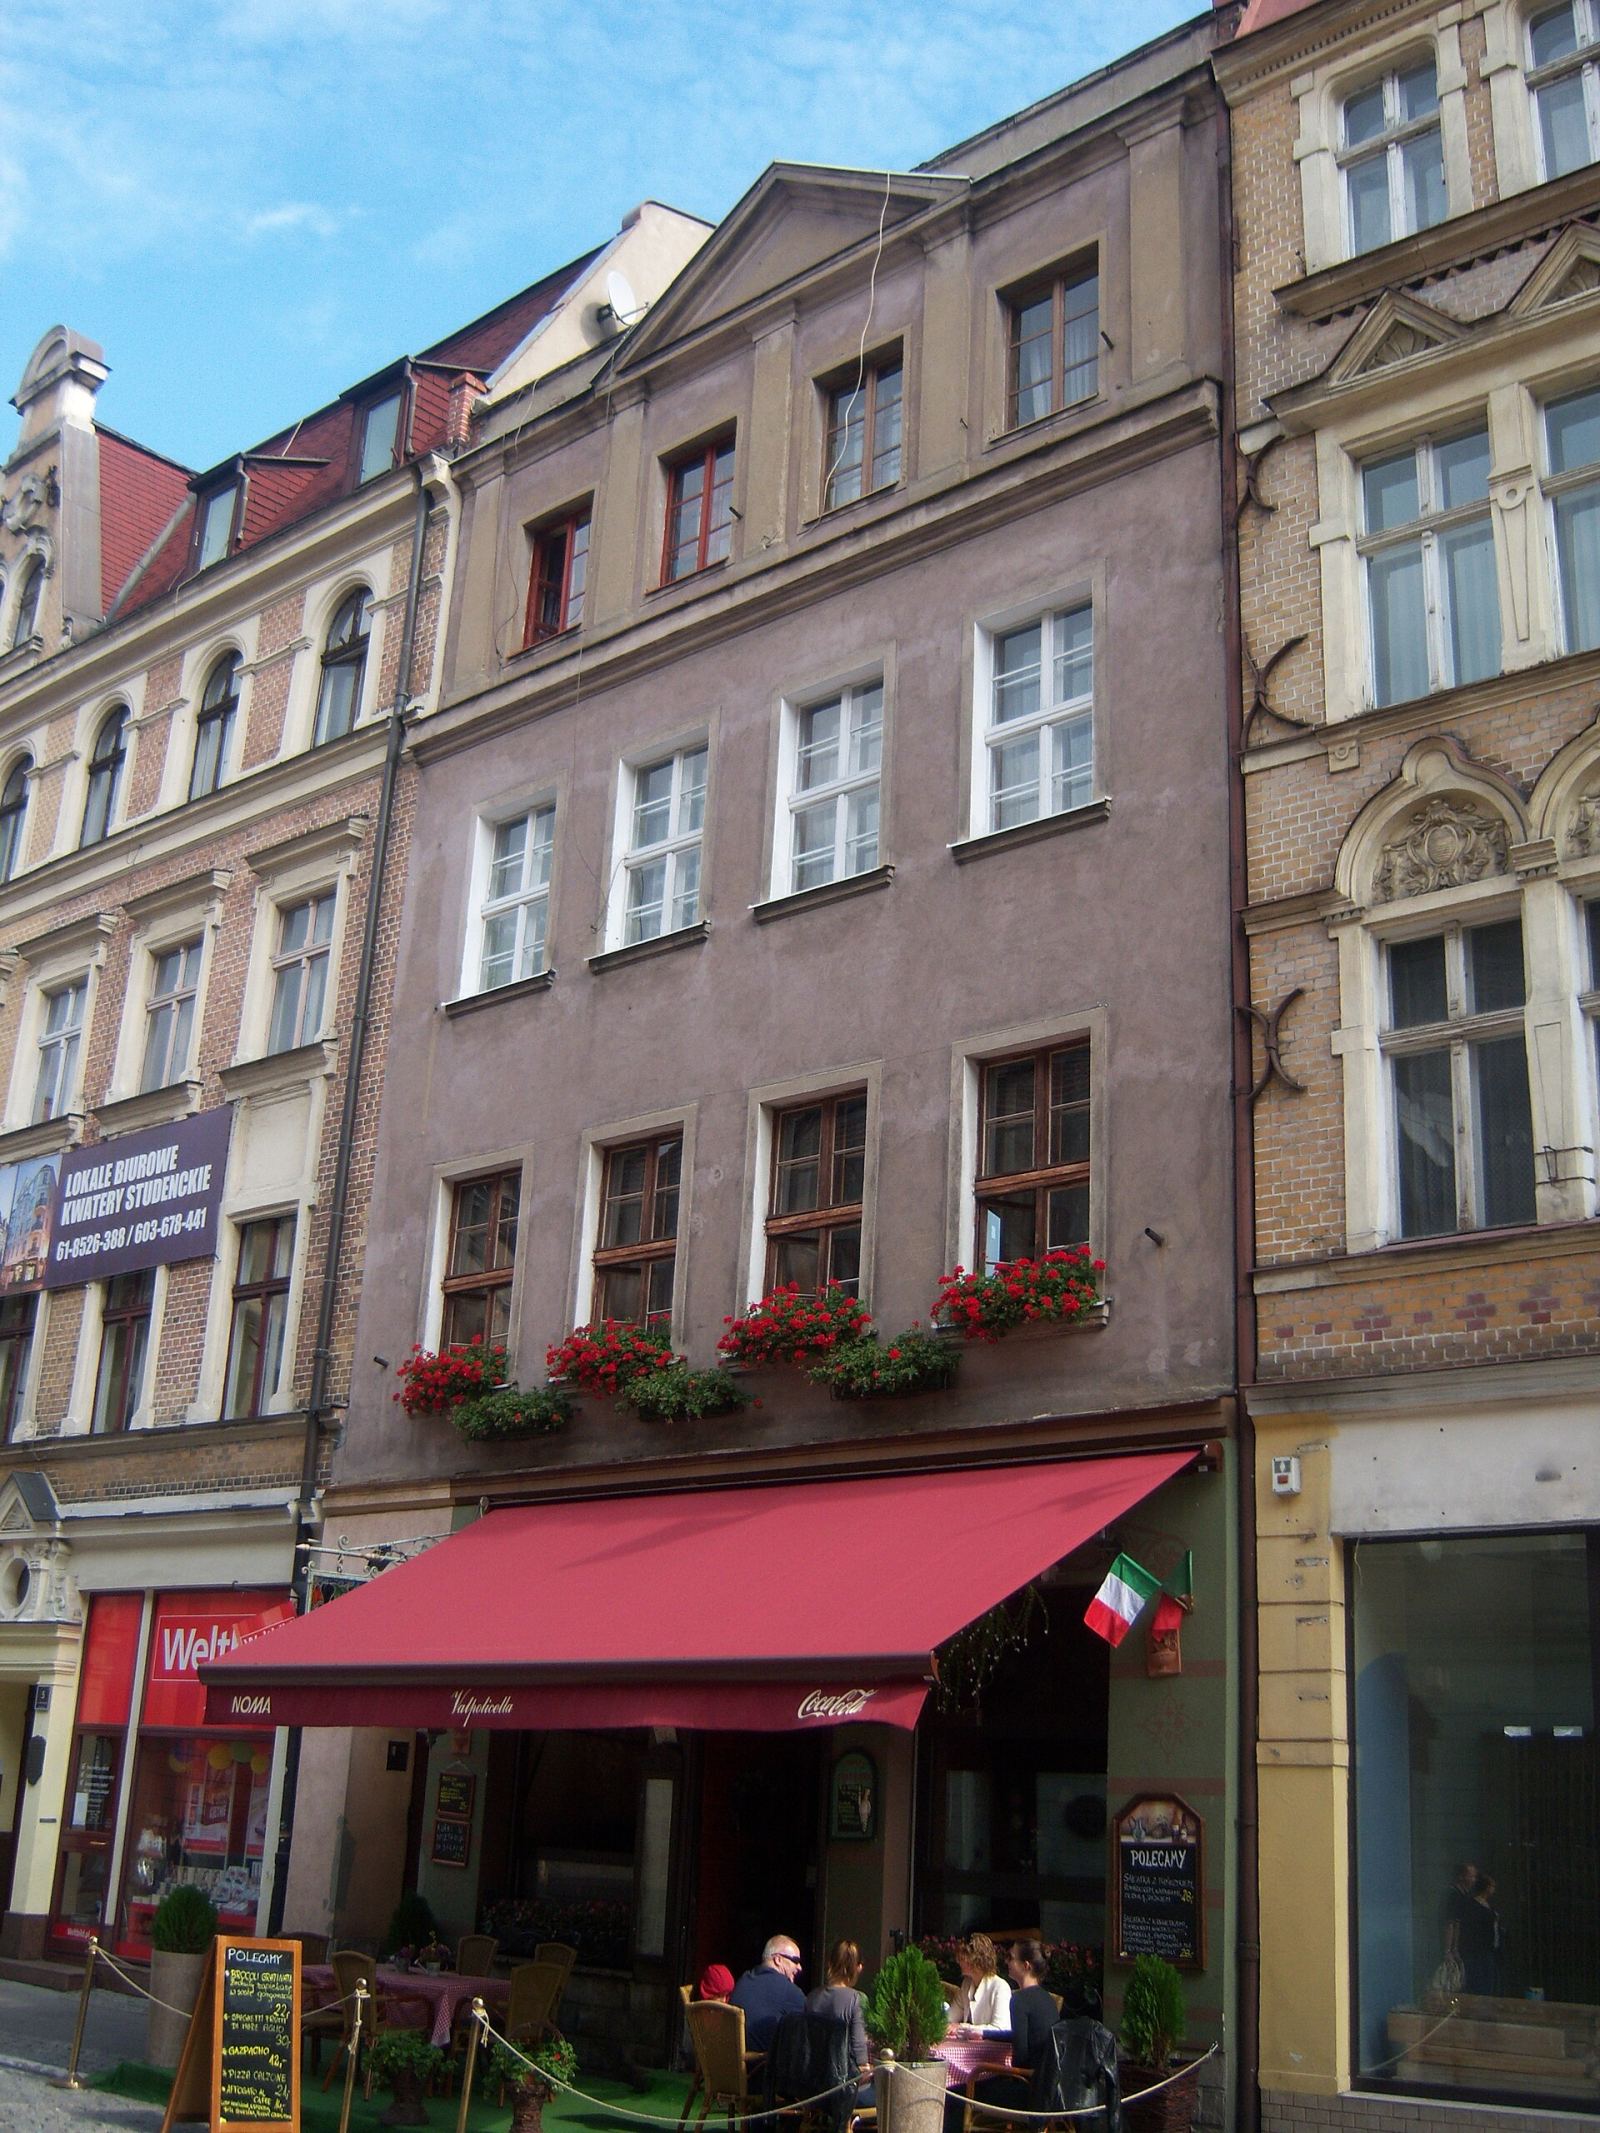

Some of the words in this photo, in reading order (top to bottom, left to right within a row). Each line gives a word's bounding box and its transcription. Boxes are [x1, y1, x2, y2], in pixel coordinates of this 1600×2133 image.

[65, 1162, 113, 1198] LOKALE
[114, 1144, 180, 1185] BIUROWE
[61, 1189, 125, 1226] KWATERY
[125, 1164, 213, 1211] STUDENCKIE
[56, 1226, 125, 1262] 61-8526-388
[126, 1225, 134, 1247] /
[135, 1207, 208, 1243] 603-678-441
[231, 1695, 271, 1715] NOMA
[451, 1688, 514, 1728] Valpolicella
[797, 1688, 878, 1719] Coca-Cola
[1130, 1849, 1187, 1869] POLECAMY
[228, 1948, 283, 1965] POLECAMY
[228, 2046, 270, 2056] GAZPACHO
[227, 2068, 251, 2079] PIZZA
[253, 2070, 287, 2082] CALZONE
